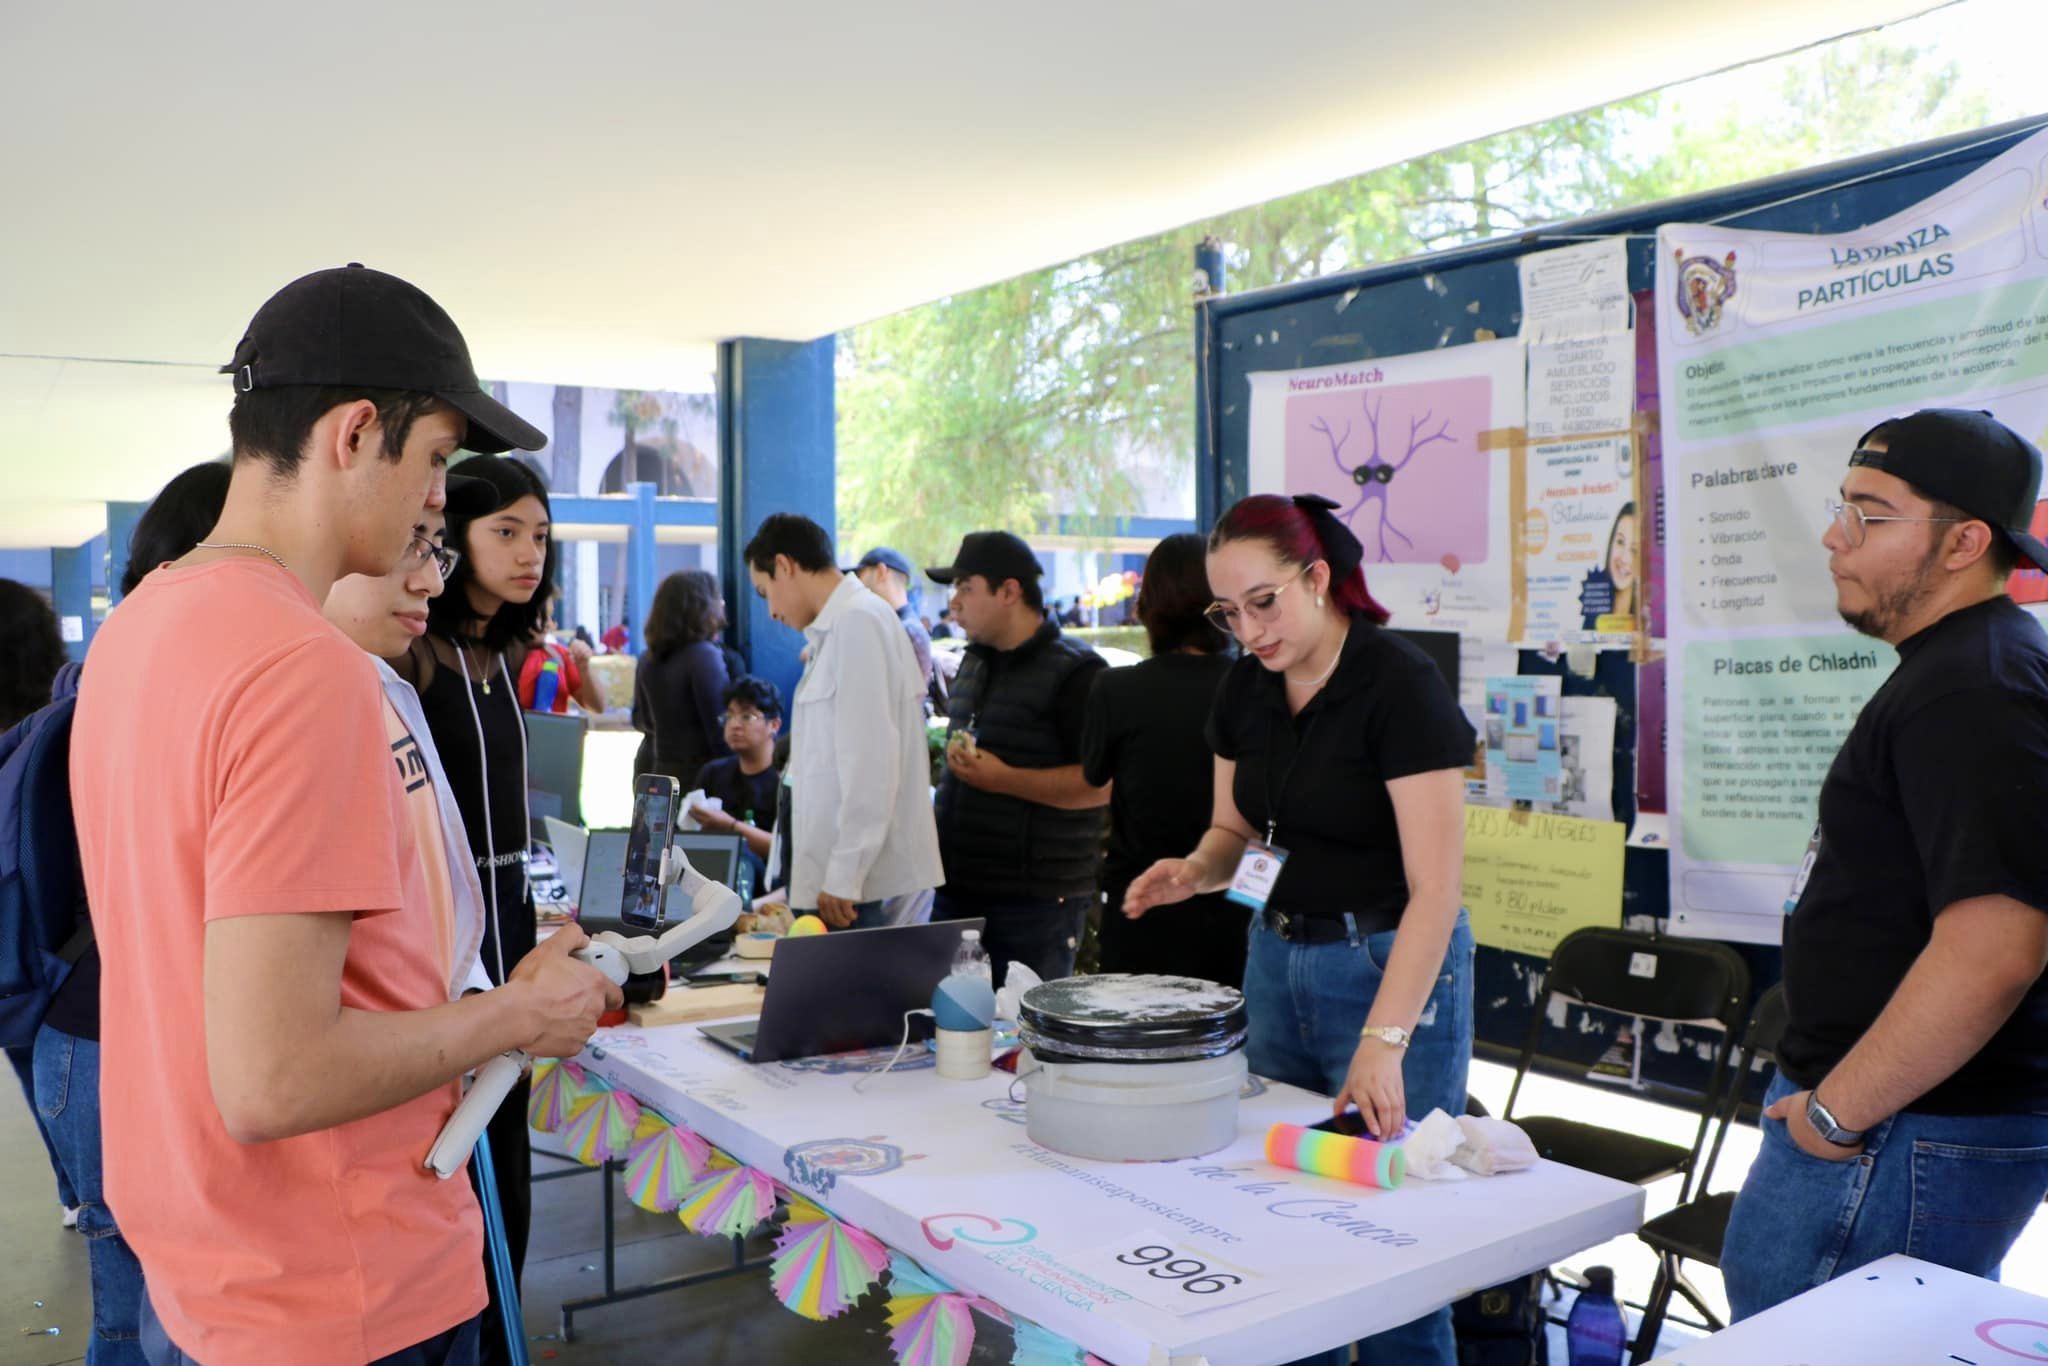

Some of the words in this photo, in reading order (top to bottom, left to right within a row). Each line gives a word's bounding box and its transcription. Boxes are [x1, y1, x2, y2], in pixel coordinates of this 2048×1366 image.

[1830, 247, 1862, 265] LA
[1798, 252, 1955, 311] PARTÍCULAS
[1887, 335, 1946, 355] frecuencia
[1959, 319, 2013, 342] amplitud
[1558, 350, 1604, 364] CUARTO
[1871, 354, 1940, 377] propagación
[1952, 336, 2021, 360] percepción
[2023, 332, 2041, 347] del
[1545, 361, 1616, 378] AMUEBLADO
[1288, 367, 1384, 391] NeuroMatch
[1551, 376, 1611, 392] SERVICIOS
[1848, 375, 1928, 397] fundamentales
[1930, 370, 1945, 382] de
[1550, 391, 1610, 405] INCLUIDOS
[1709, 509, 1751, 524] Sonido
[1711, 529, 1767, 544] Vibración
[1711, 554, 1742, 566] Onda
[1712, 572, 1778, 588] Frecuencia
[1712, 594, 1765, 611] Longitud
[1713, 658, 1774, 675] Placas
[1779, 655, 1802, 673] de
[1808, 650, 1878, 672] Chladni
[1234, 1180, 1291, 1196] la
[1266, 1199, 1419, 1247] Ciencia
[1116, 1244, 1243, 1295] 996
[1030, 1273, 1095, 1312] CIENCIA
